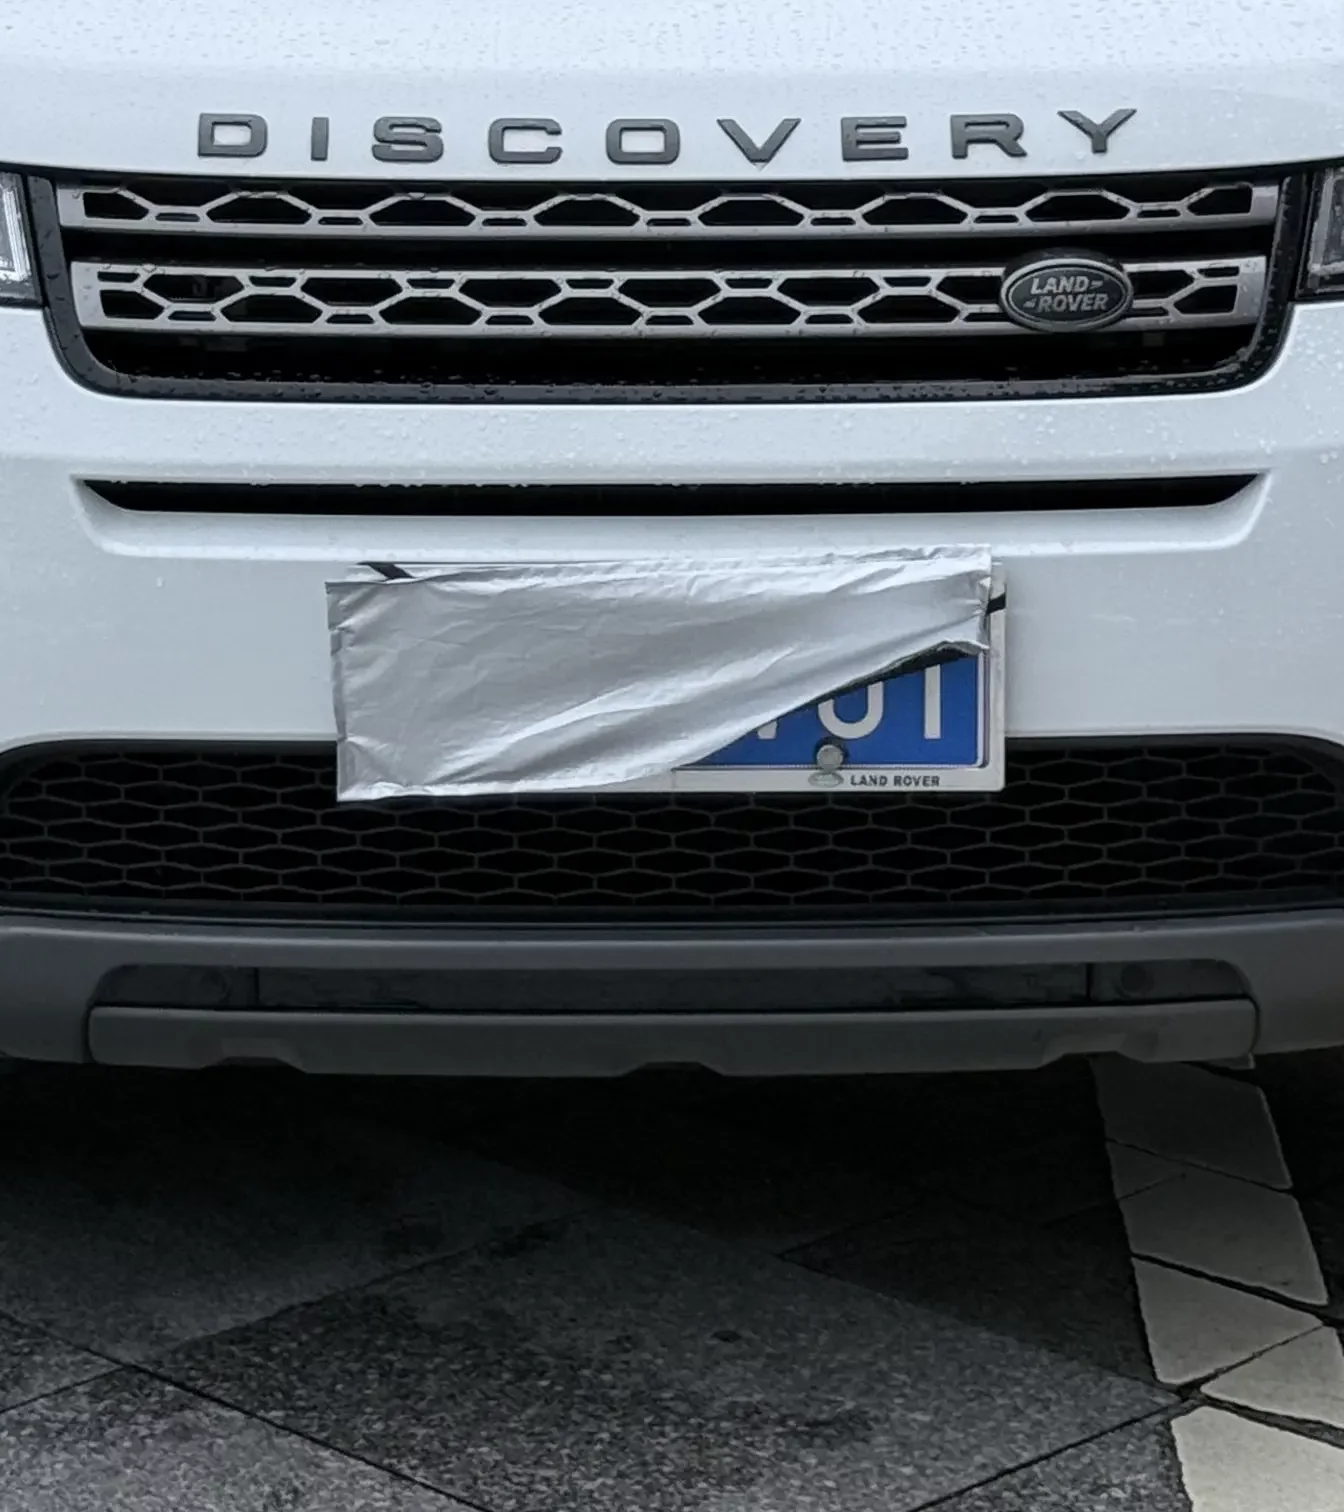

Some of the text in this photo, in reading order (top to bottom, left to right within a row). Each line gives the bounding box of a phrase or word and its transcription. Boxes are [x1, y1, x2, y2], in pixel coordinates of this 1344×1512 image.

[197, 108, 1137, 164] DISCOVERY
[1030, 275, 1090, 295] LAND
[1037, 293, 1109, 313] ROVER
[850, 774, 940, 788] LAND ROVER
